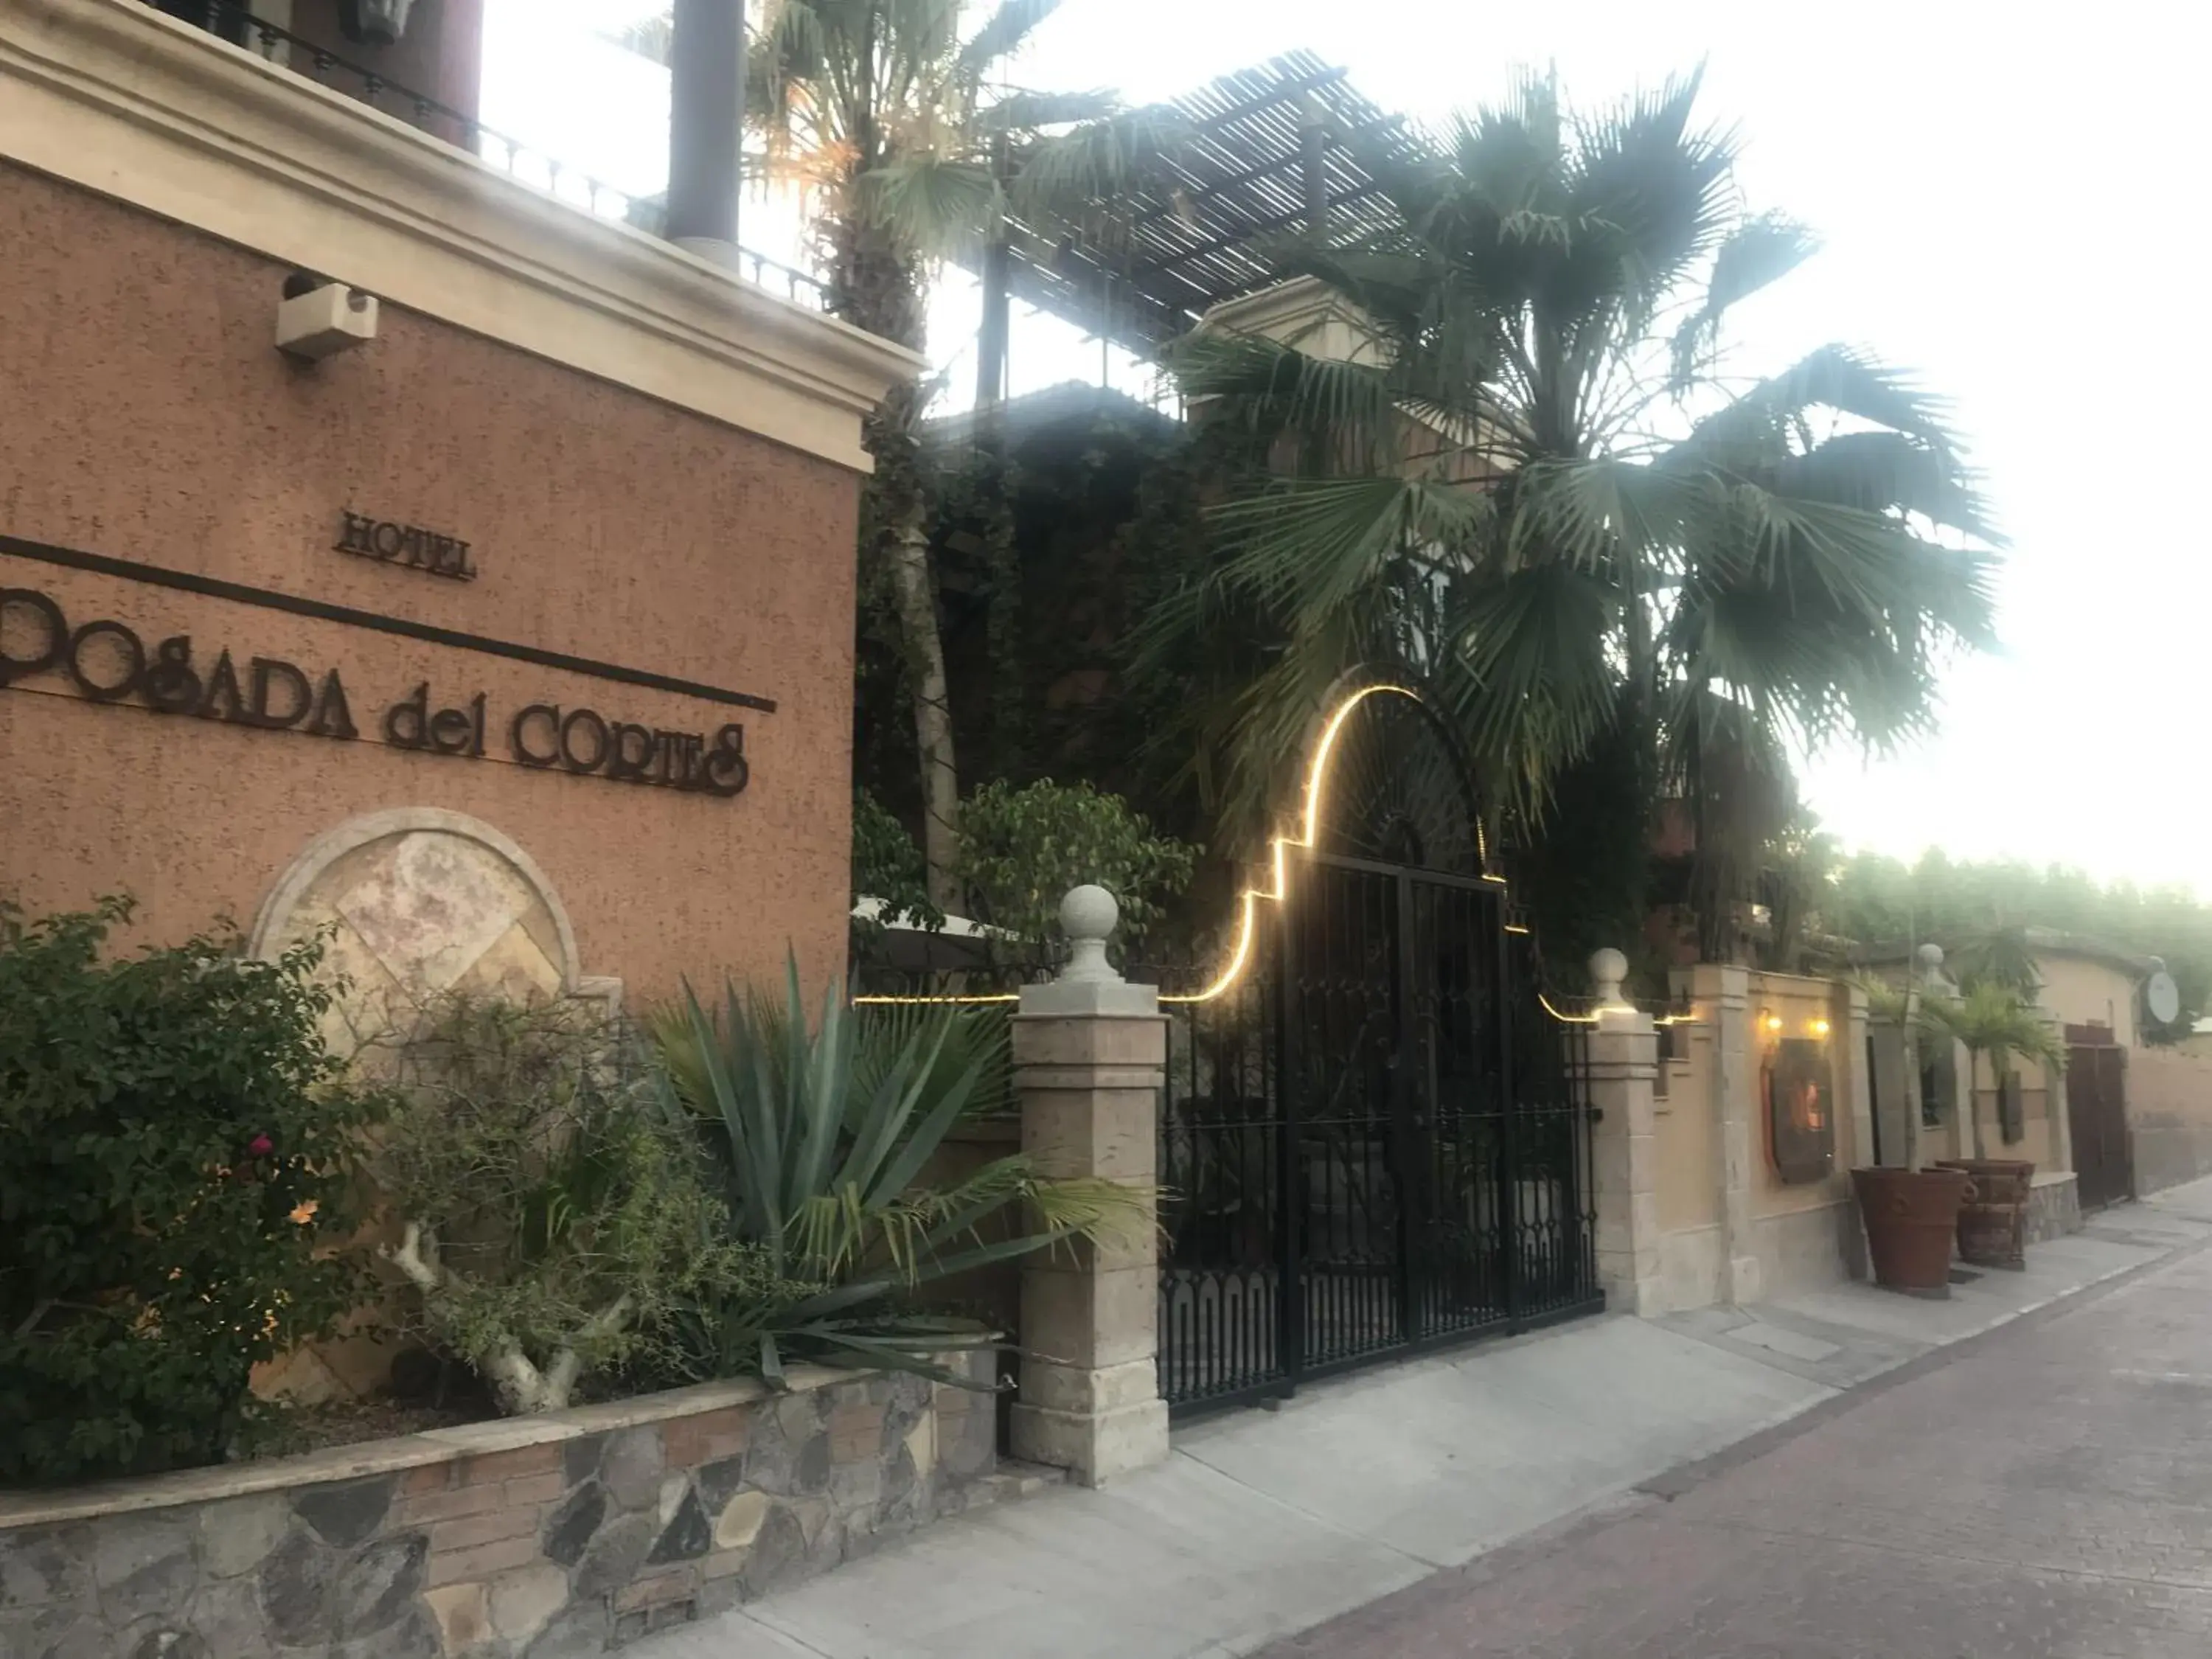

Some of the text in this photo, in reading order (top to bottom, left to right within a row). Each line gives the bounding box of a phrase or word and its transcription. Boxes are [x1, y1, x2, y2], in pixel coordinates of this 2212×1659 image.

[336, 510, 477, 580] HOTEL
[0, 588, 748, 797] POSADA del CORTES
